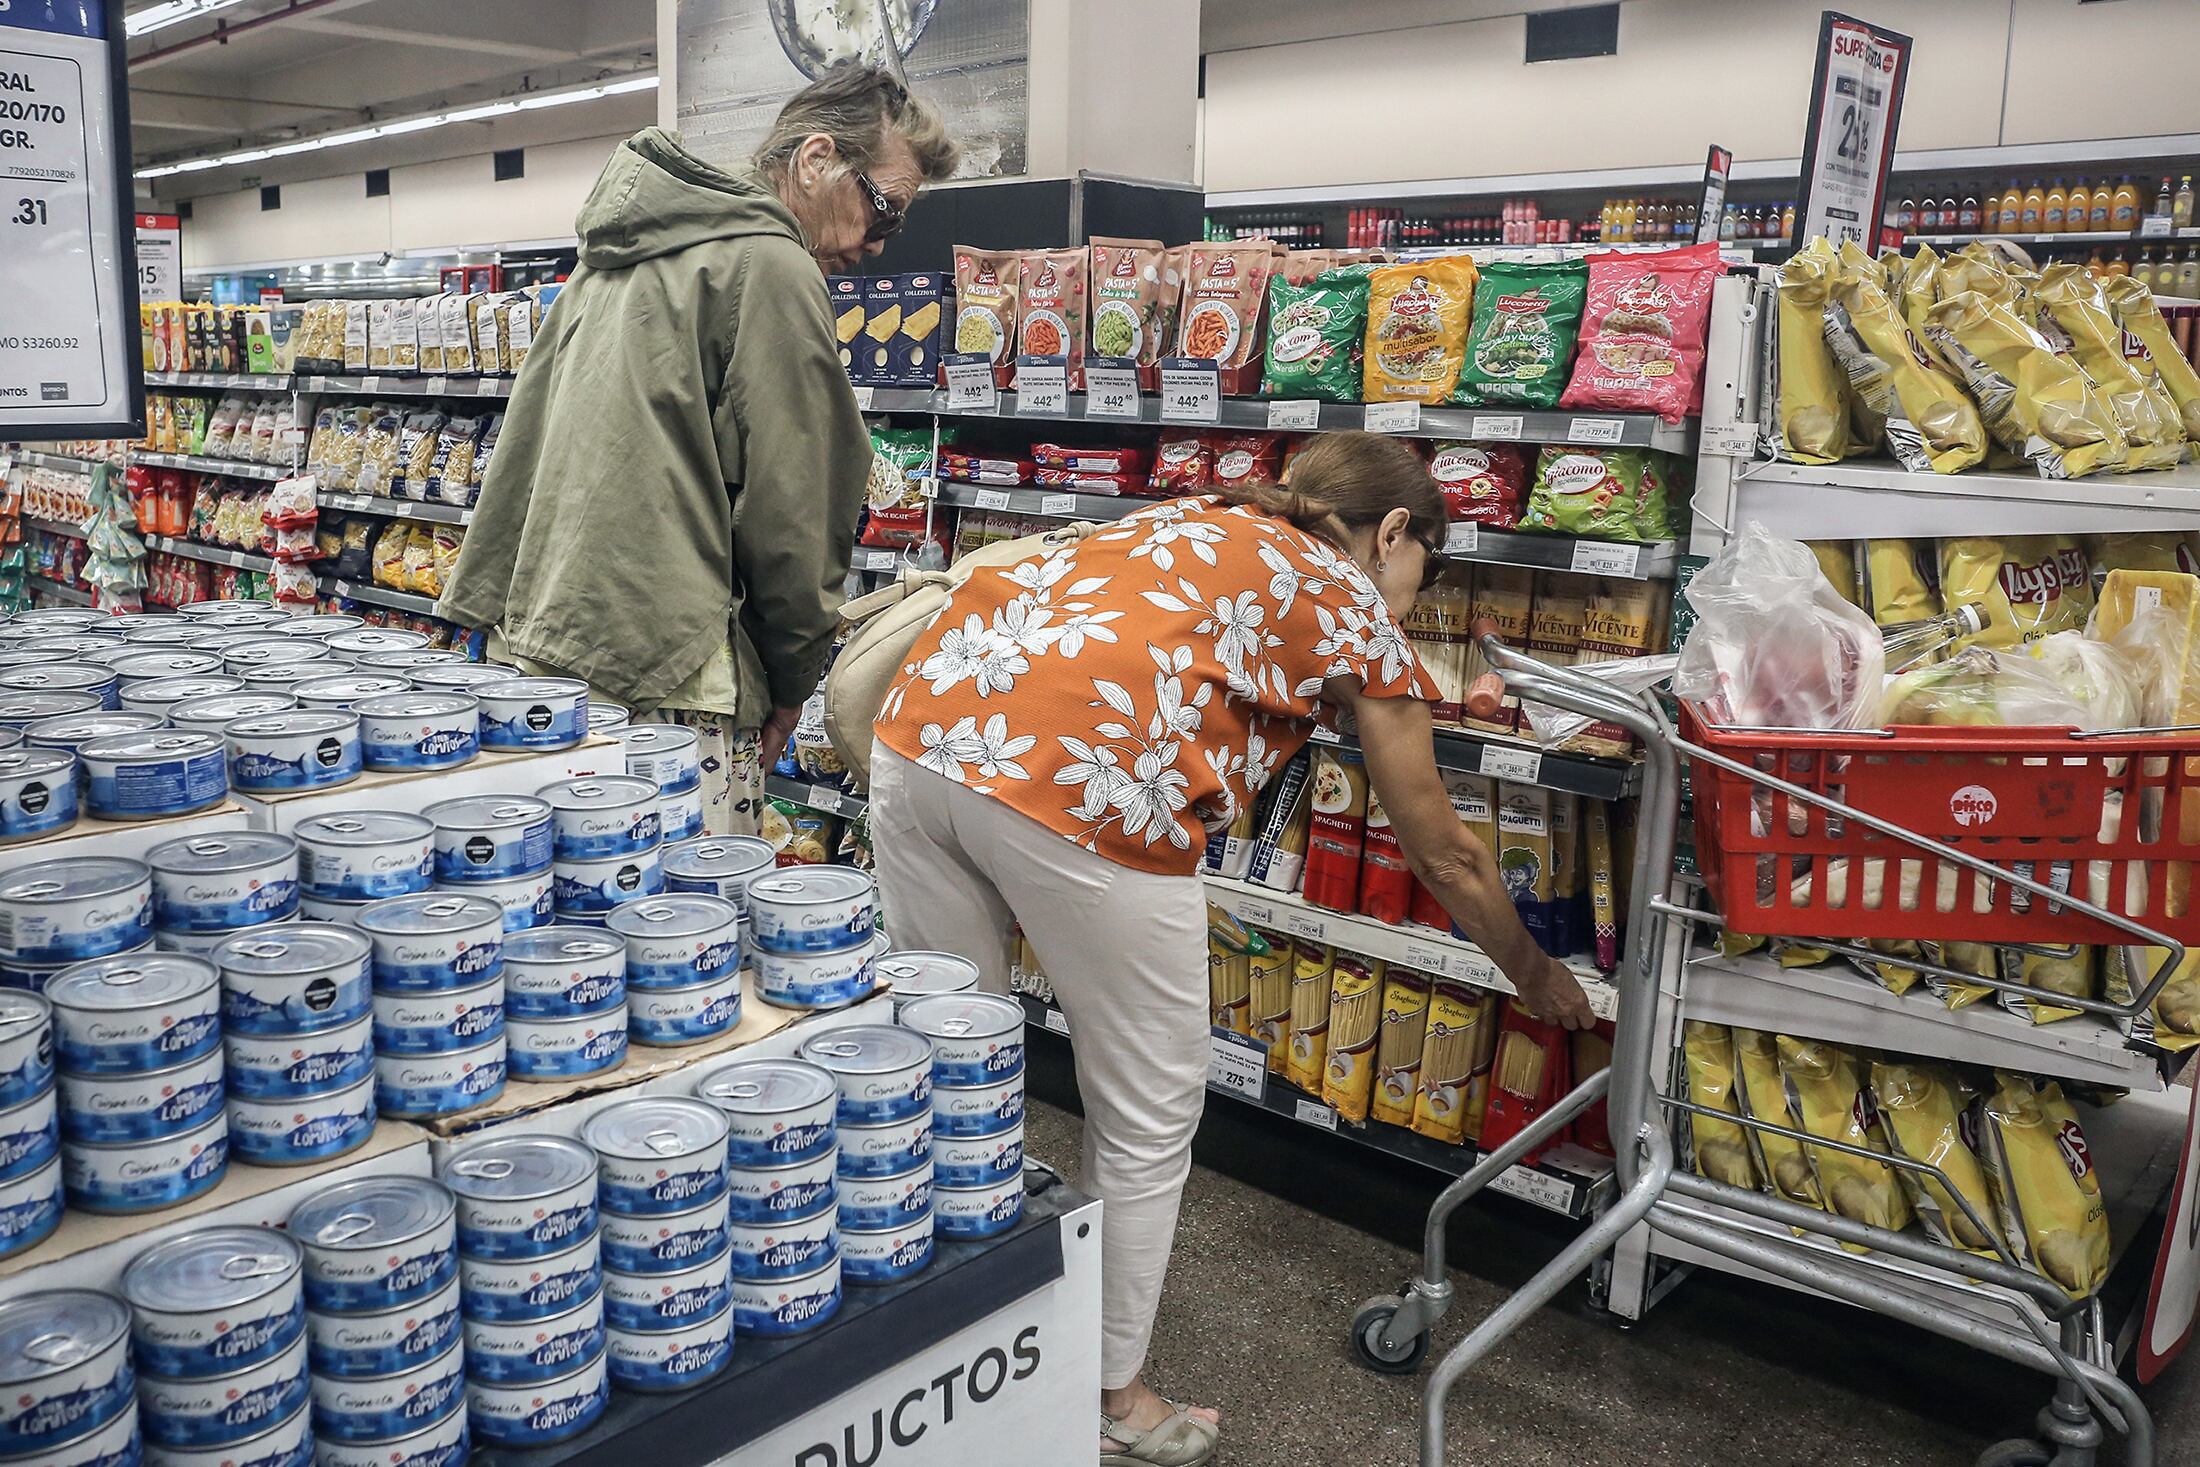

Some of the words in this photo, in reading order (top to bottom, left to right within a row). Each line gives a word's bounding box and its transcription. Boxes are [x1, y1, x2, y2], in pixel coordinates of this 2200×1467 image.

[1498, 297, 1546, 307] Lucchetti
[22, 337, 79, 349] $3260.92
[1383, 334, 1438, 351] multisabor
[1033, 395, 1052, 406] 442
[1104, 395, 1123, 407] 442
[1177, 395, 1198, 407] 442
[1546, 464, 1603, 485] giacomo
[1584, 608, 1639, 639] VICENTE
[371, 728, 399, 740] Cuisine
[421, 738, 460, 755] LOMITOS
[1314, 814, 1352, 831] SPAGHETTI
[1500, 813, 1541, 827] SPAGUETTI
[696, 951, 730, 972] LOMITOS
[514, 973, 546, 988] Cuisine
[570, 983, 612, 1004] LOMITOS
[1390, 990, 1421, 1006] Spaghetti
[1438, 1002, 1471, 1020] Spaghetti
[936, 1047, 963, 1060] Cuisine
[1226, 1071, 1244, 1087] 275
[865, 1083, 892, 1097] Cuisine
[951, 1099, 978, 1112] Cuisine
[293, 1124, 344, 1147] LOMITOS
[773, 1134, 813, 1153] LOMITOS
[655, 1177, 702, 1201] LOMITOS
[770, 1189, 813, 1211] LOMITOS
[658, 1234, 703, 1260] LOMITOS
[764, 1245, 808, 1268] LOMITOS
[662, 1291, 707, 1317] LOMITOS
[778, 1301, 820, 1324] LOMITOS
[668, 1348, 712, 1373] LOMITOS
